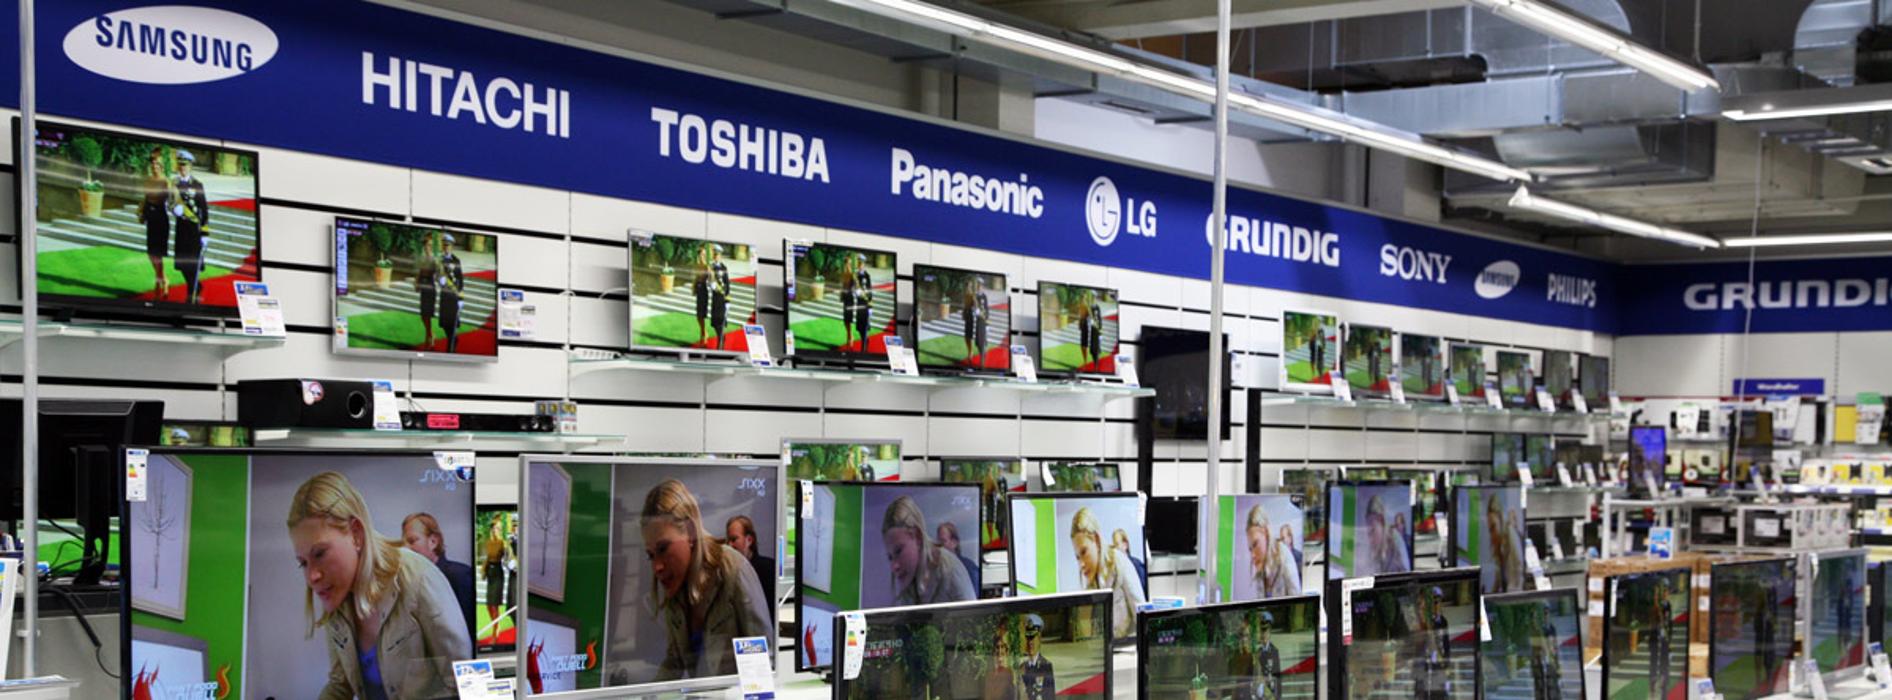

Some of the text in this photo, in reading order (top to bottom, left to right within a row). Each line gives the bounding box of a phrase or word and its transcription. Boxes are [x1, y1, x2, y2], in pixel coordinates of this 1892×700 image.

[95, 15, 253, 72] SAMSUNG
[361, 50, 570, 139] HITACHI
[650, 106, 831, 184] TOSHIBA
[891, 147, 1044, 219] Panasonic
[1126, 198, 1157, 237] LG
[1379, 243, 1452, 284] SONY
[1481, 270, 1515, 288] SAMSUNG
[1546, 272, 1597, 309] PHILIPS
[1683, 278, 1892, 311] GRUNDI
